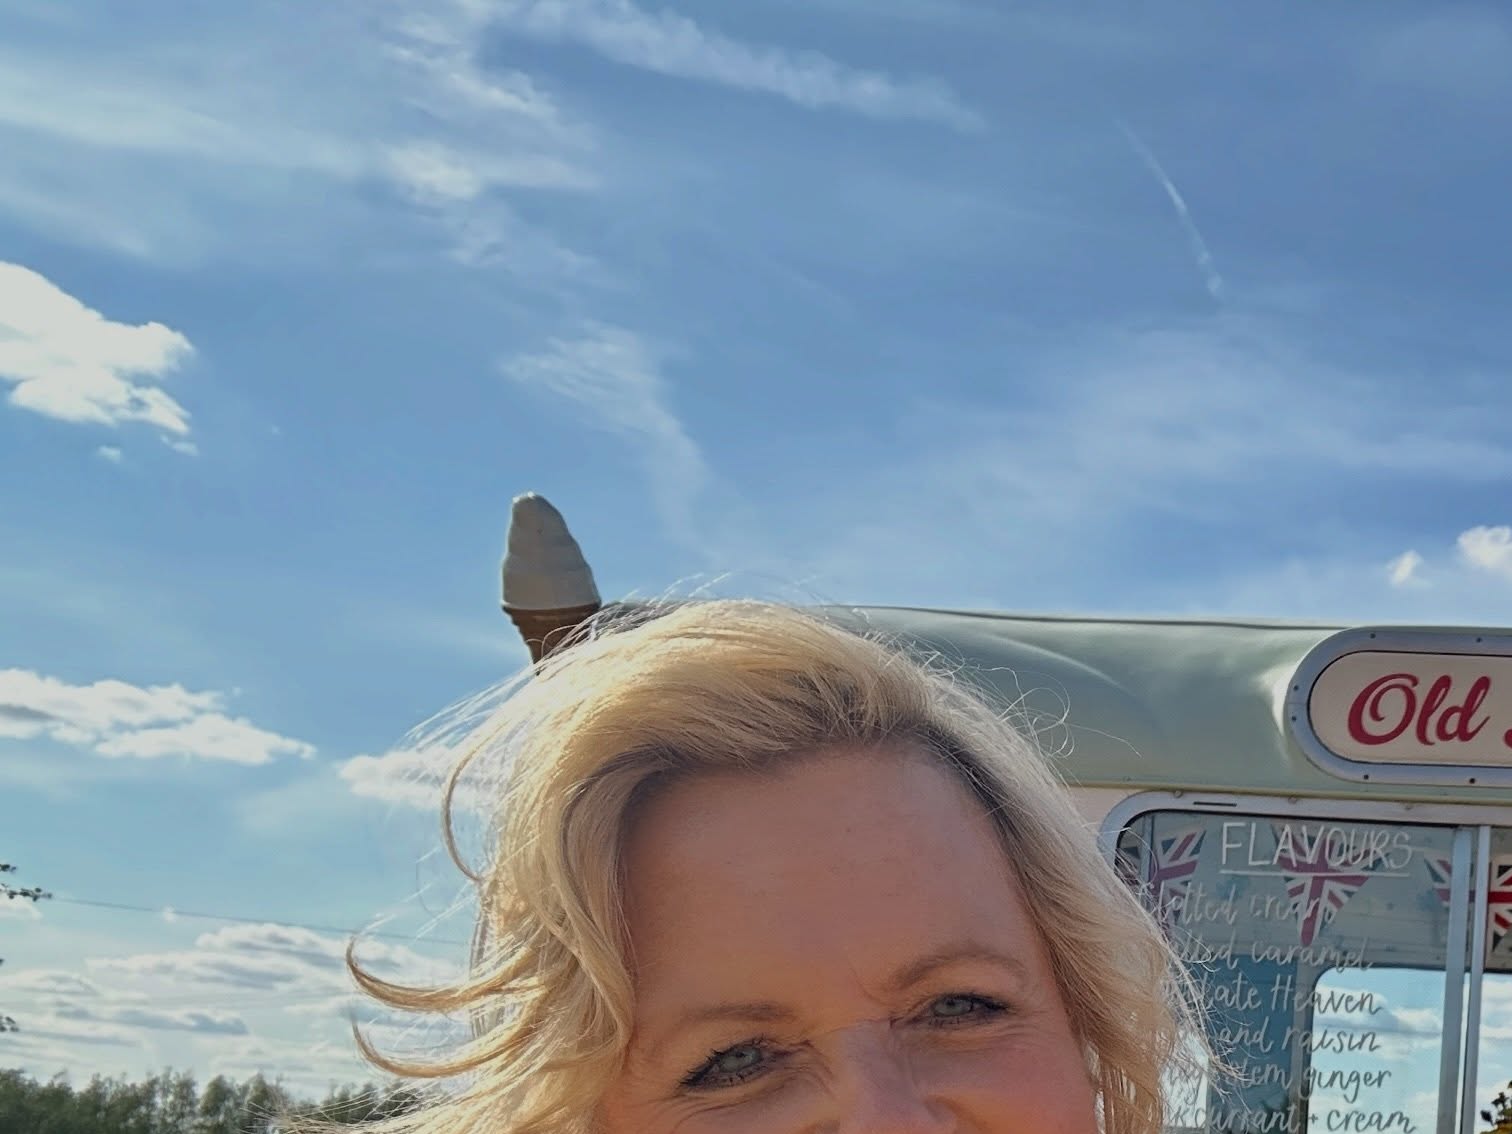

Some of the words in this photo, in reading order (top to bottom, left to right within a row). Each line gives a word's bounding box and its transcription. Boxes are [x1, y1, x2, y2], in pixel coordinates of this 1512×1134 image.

[1347, 673, 1491, 745] Old
[1219, 822, 1412, 870] FLAVOURS
[1150, 880, 1238, 926] lotted
[1270, 973, 1383, 1016] Heaven
[1281, 1026, 1382, 1053] raisin
[1300, 1067, 1392, 1104] ginger
[1326, 1107, 1417, 1134] cream
